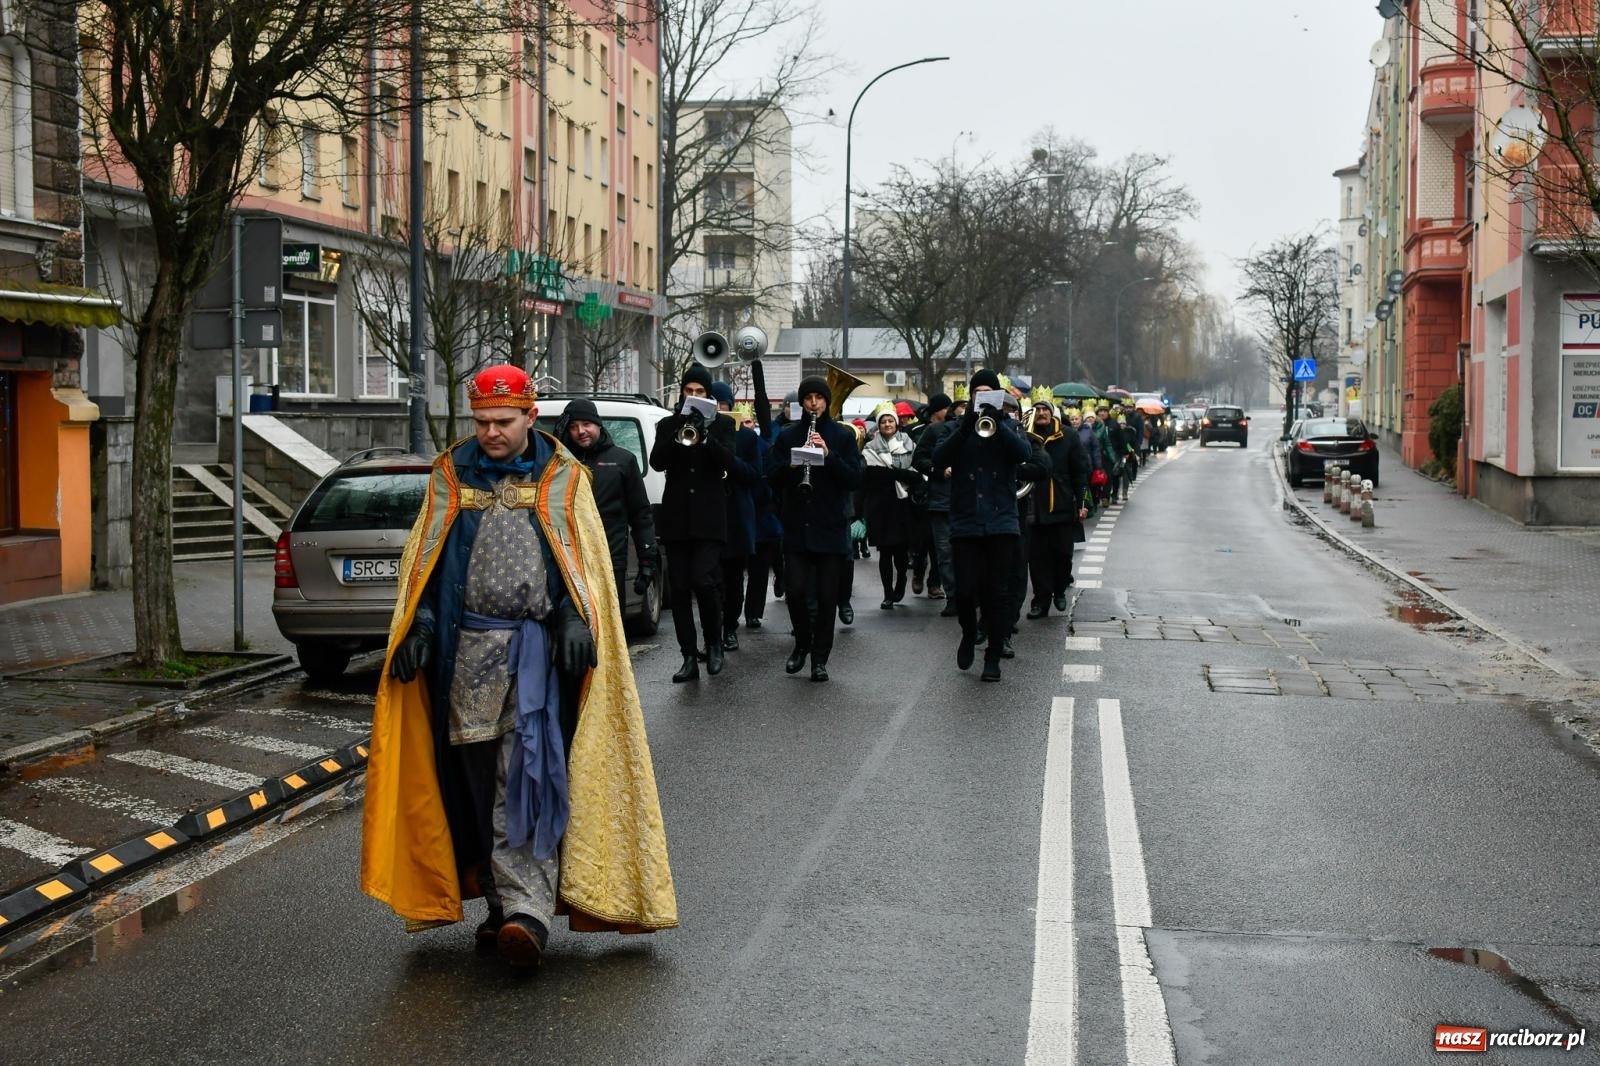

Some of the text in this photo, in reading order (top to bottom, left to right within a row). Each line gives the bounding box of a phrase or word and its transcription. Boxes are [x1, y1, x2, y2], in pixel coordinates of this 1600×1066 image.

[282, 255, 310, 265] ommy
[1579, 314, 1600, 328] PU
[1578, 405, 1592, 415] OC
[354, 560, 400, 575] SRC 5
